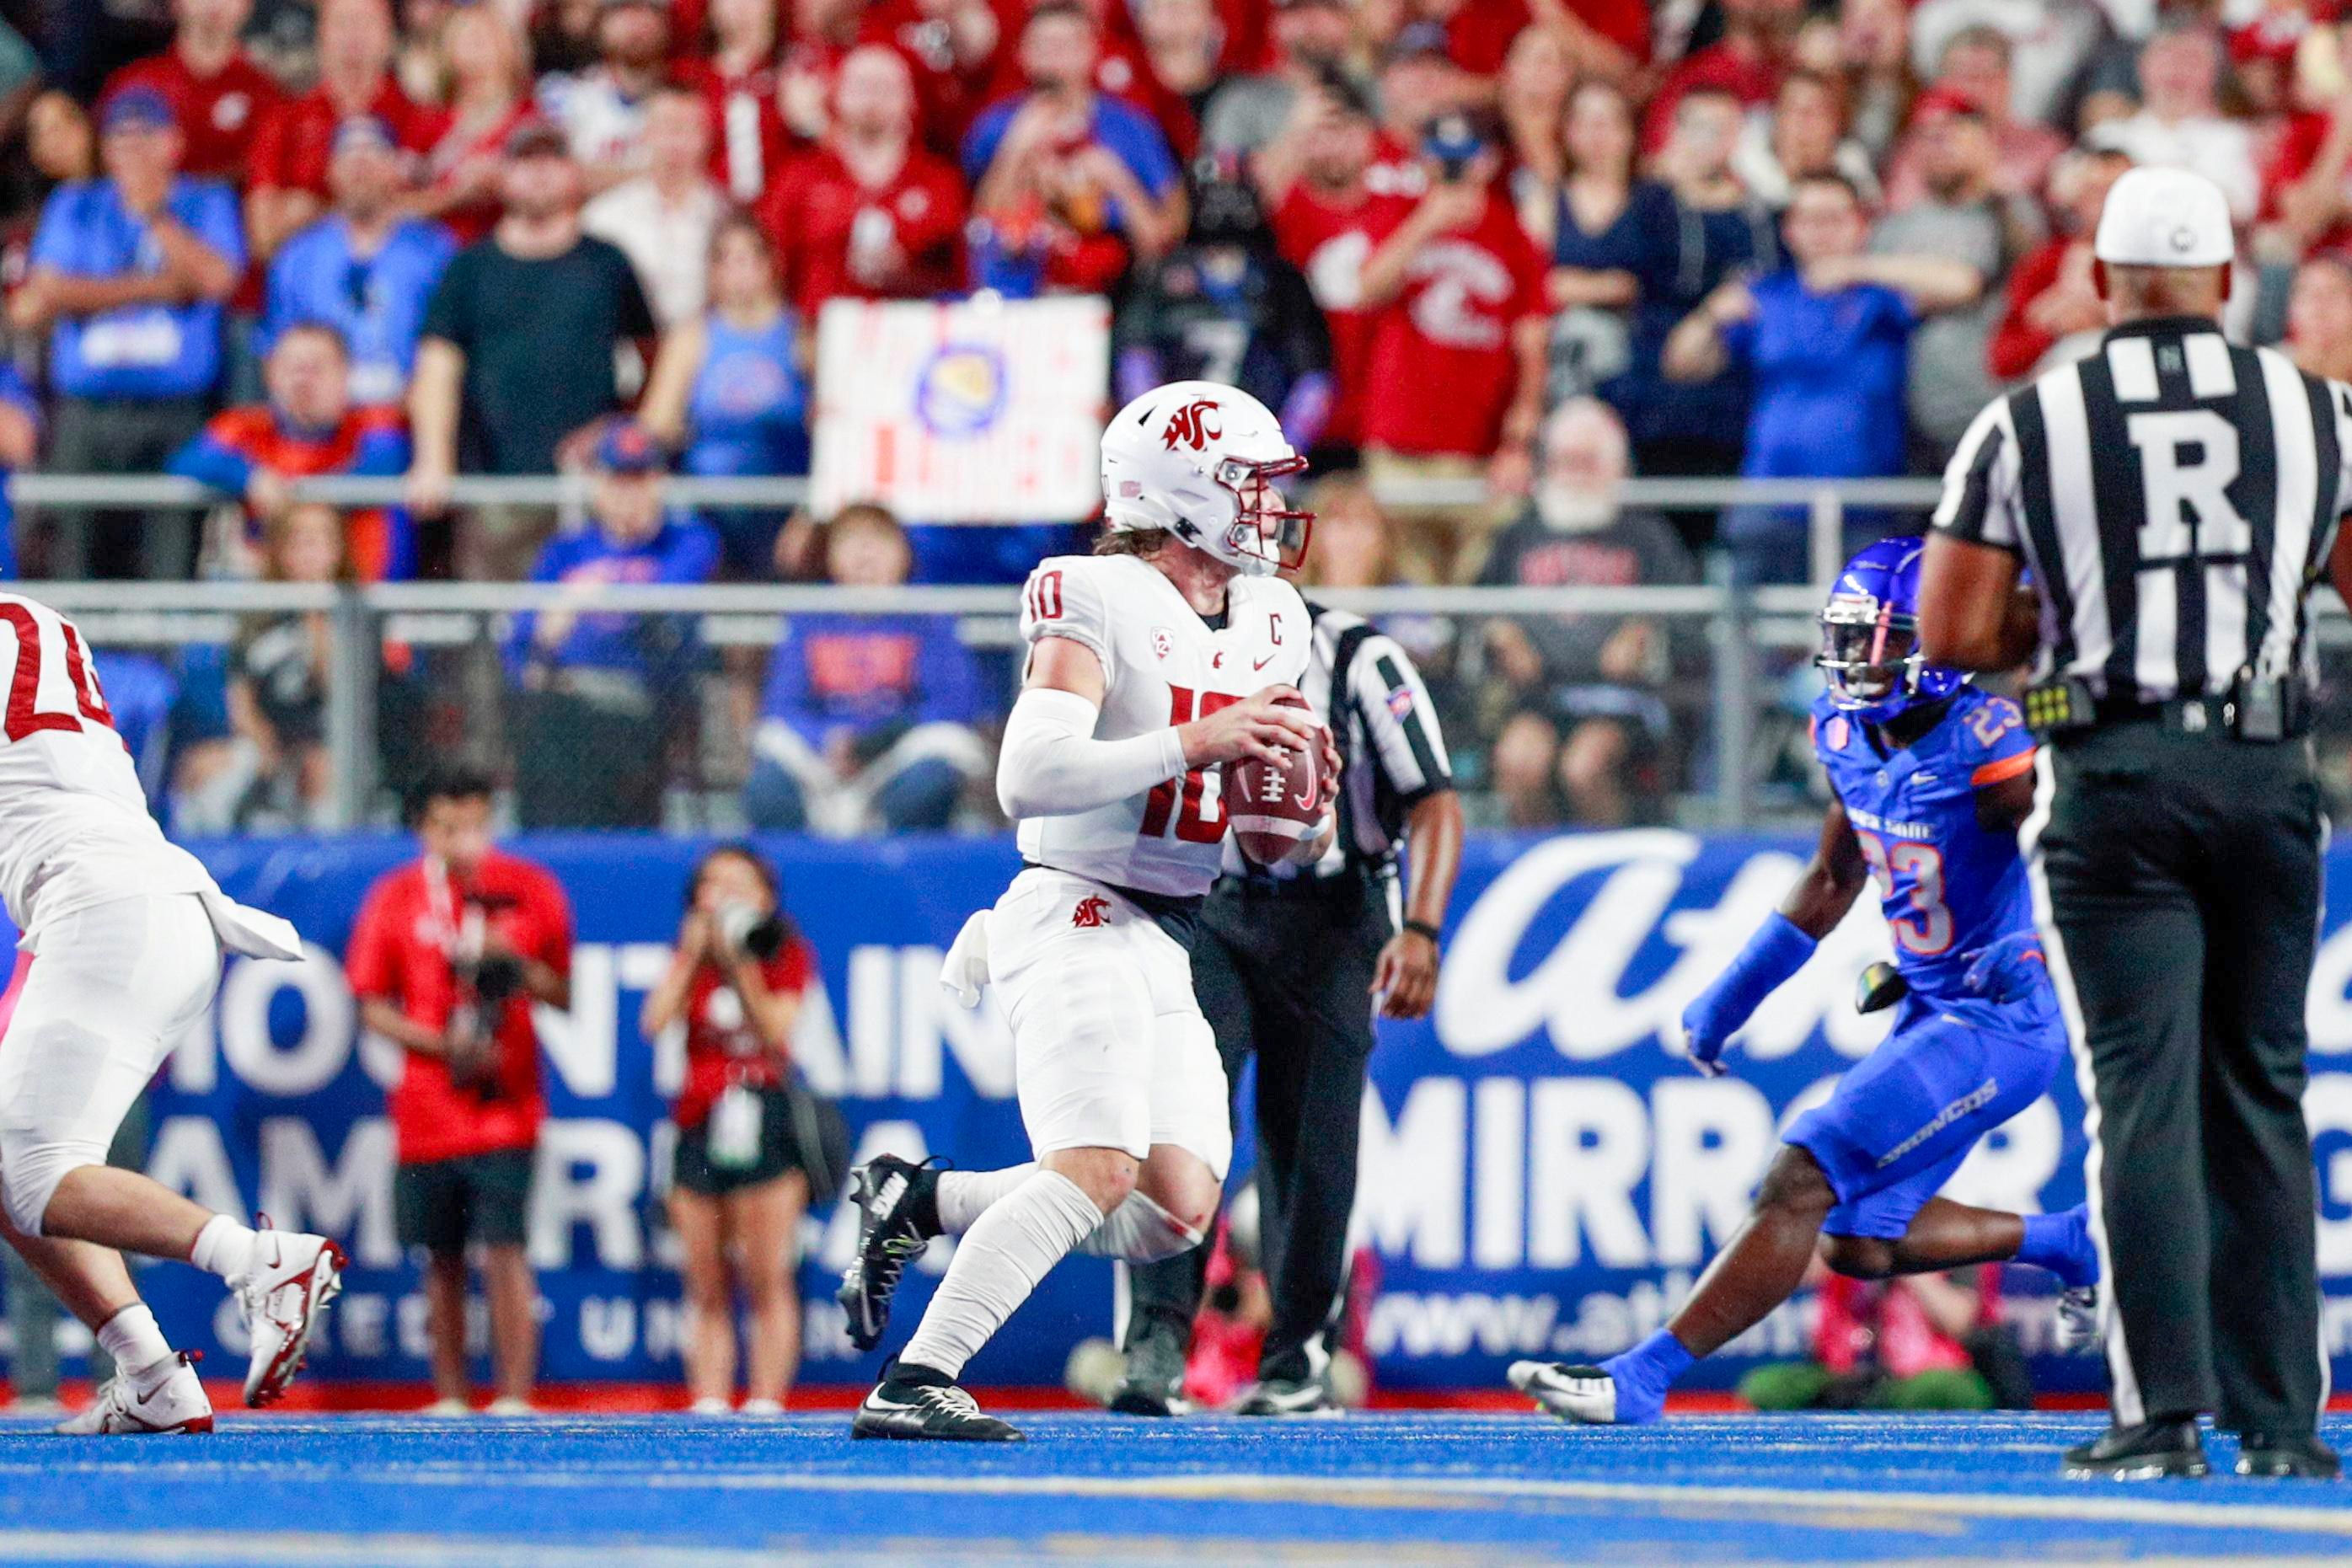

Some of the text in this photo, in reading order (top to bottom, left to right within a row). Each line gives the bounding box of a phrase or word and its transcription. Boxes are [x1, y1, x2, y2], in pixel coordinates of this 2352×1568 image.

[2126, 409, 2252, 560] R
[1028, 570, 1063, 622] 10
[1269, 613, 1282, 646] C
[1962, 696, 2023, 748] 23
[170, 942, 1018, 1098] ONTAIN
[126, 1114, 961, 1269] AMRIA
